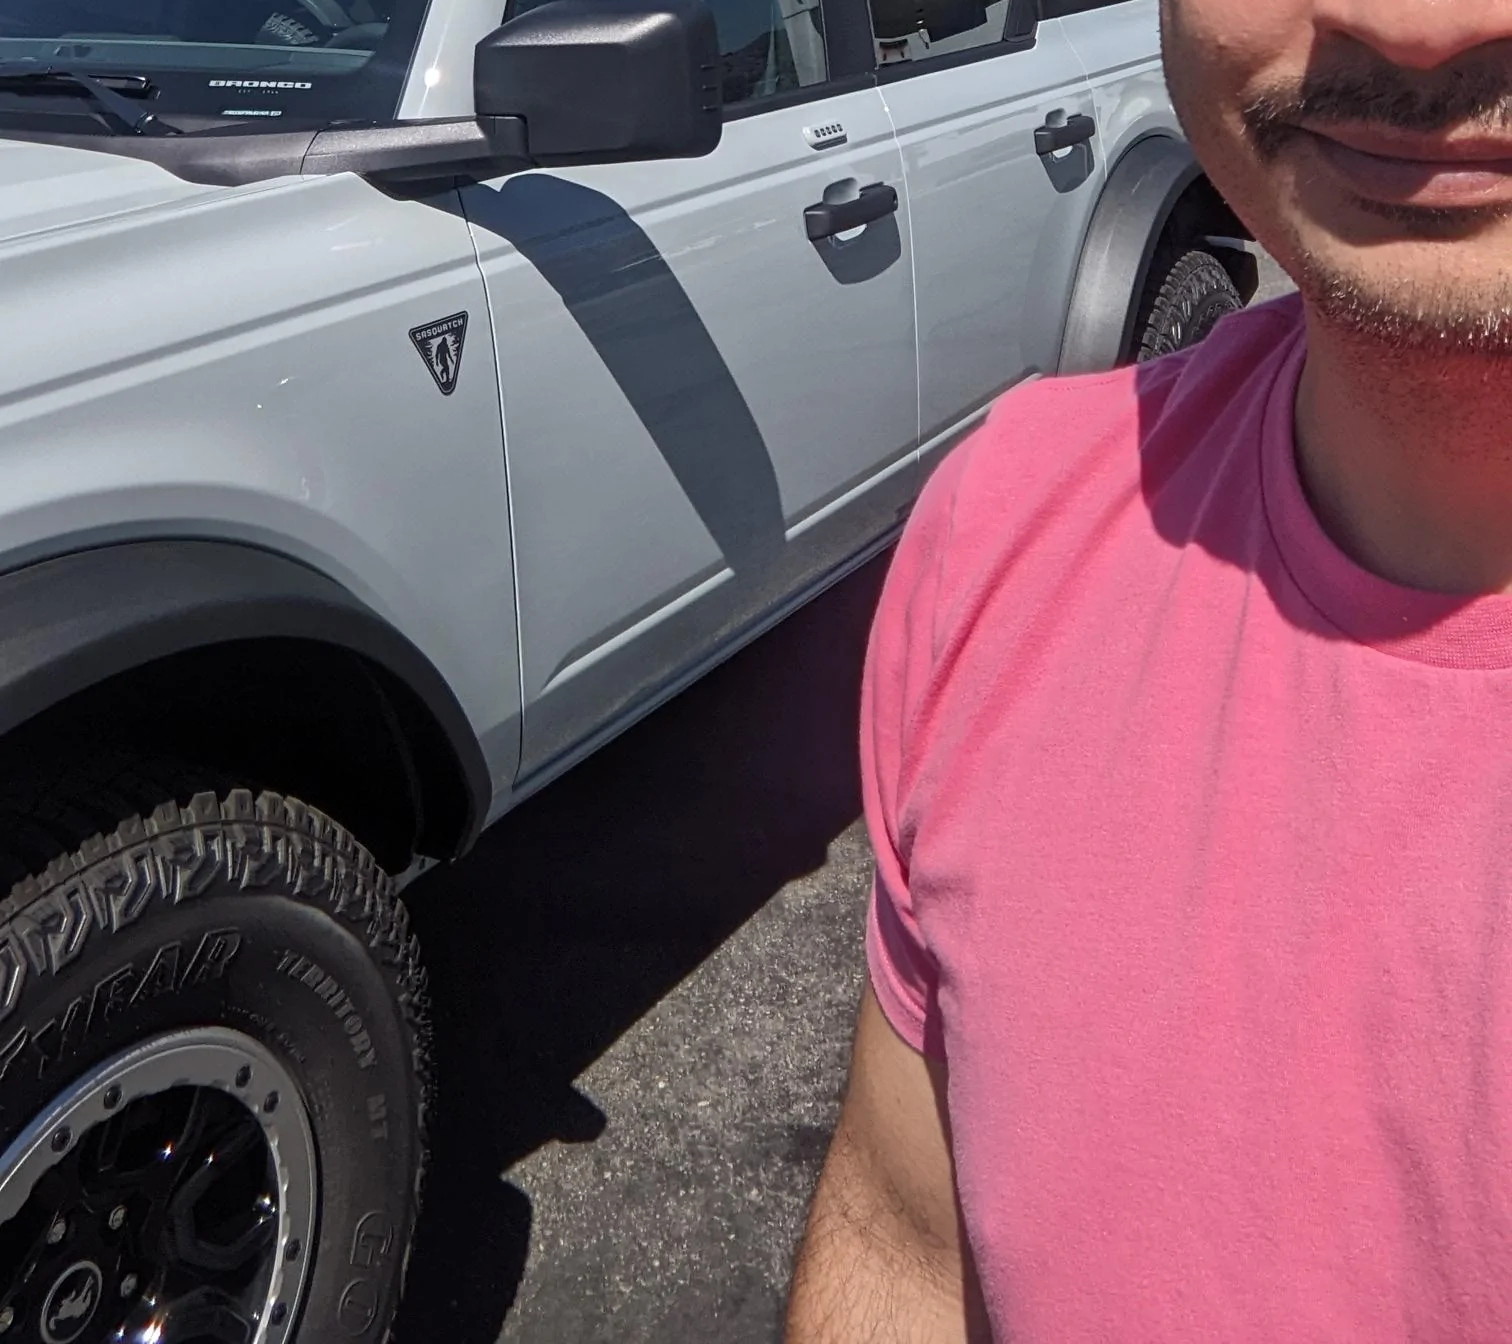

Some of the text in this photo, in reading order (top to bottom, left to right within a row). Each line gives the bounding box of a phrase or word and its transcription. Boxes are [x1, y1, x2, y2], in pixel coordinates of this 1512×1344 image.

[208, 80, 312, 89] BRONCO
[416, 318, 463, 341] SASQUATCH
[277, 949, 378, 1070] TERRITORY
[366, 1094, 389, 1141] MT
